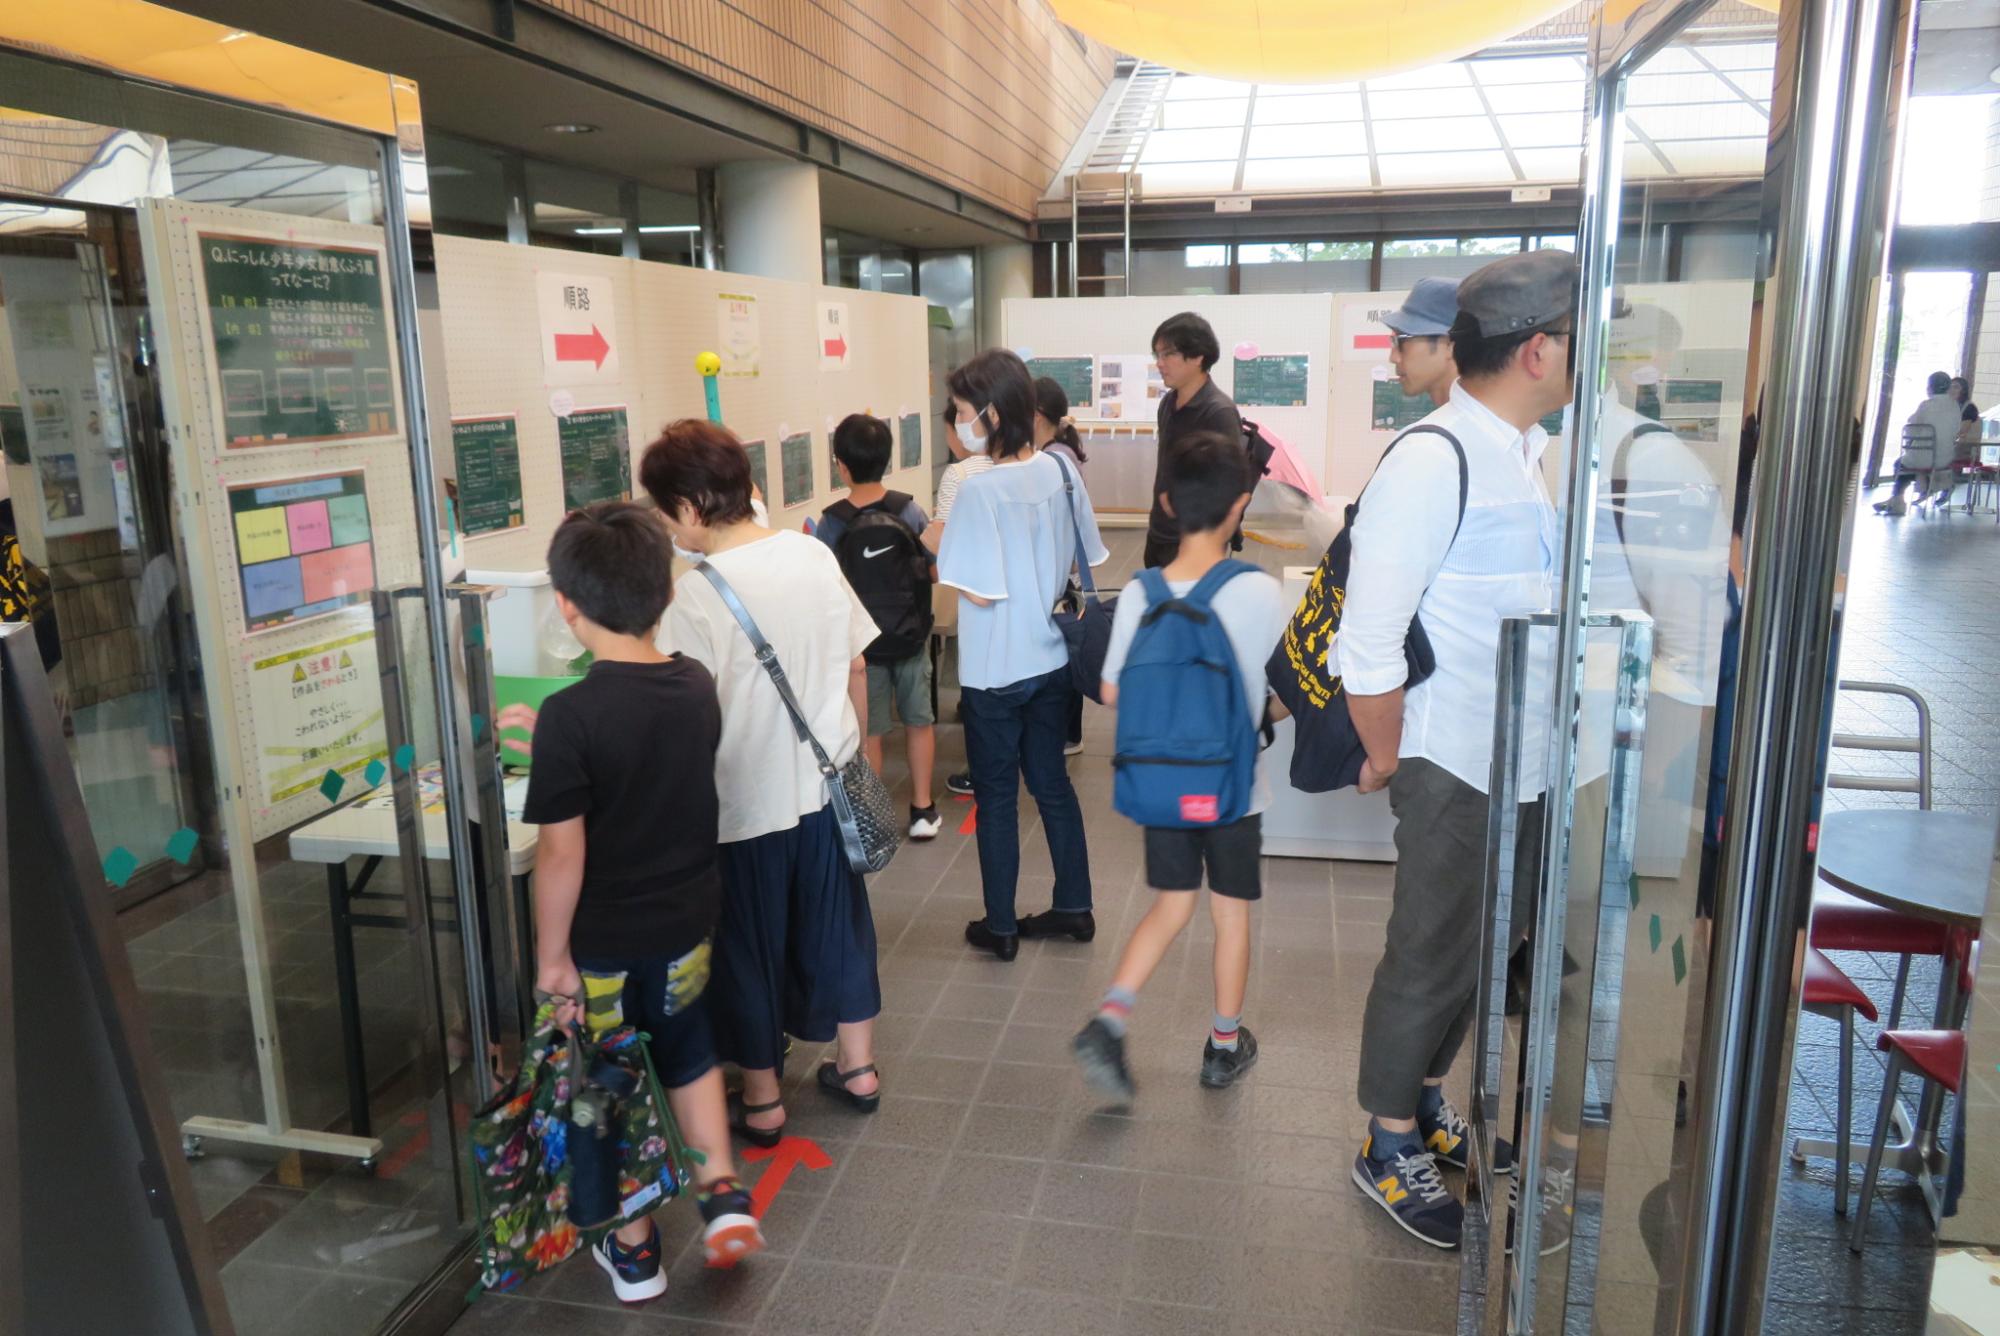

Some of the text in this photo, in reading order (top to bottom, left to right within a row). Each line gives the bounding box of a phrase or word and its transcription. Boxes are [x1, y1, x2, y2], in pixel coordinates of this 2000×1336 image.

[563, 284, 591, 312] 順路
[1427, 1129, 1461, 1153] N
[1377, 1175, 1408, 1205] N
